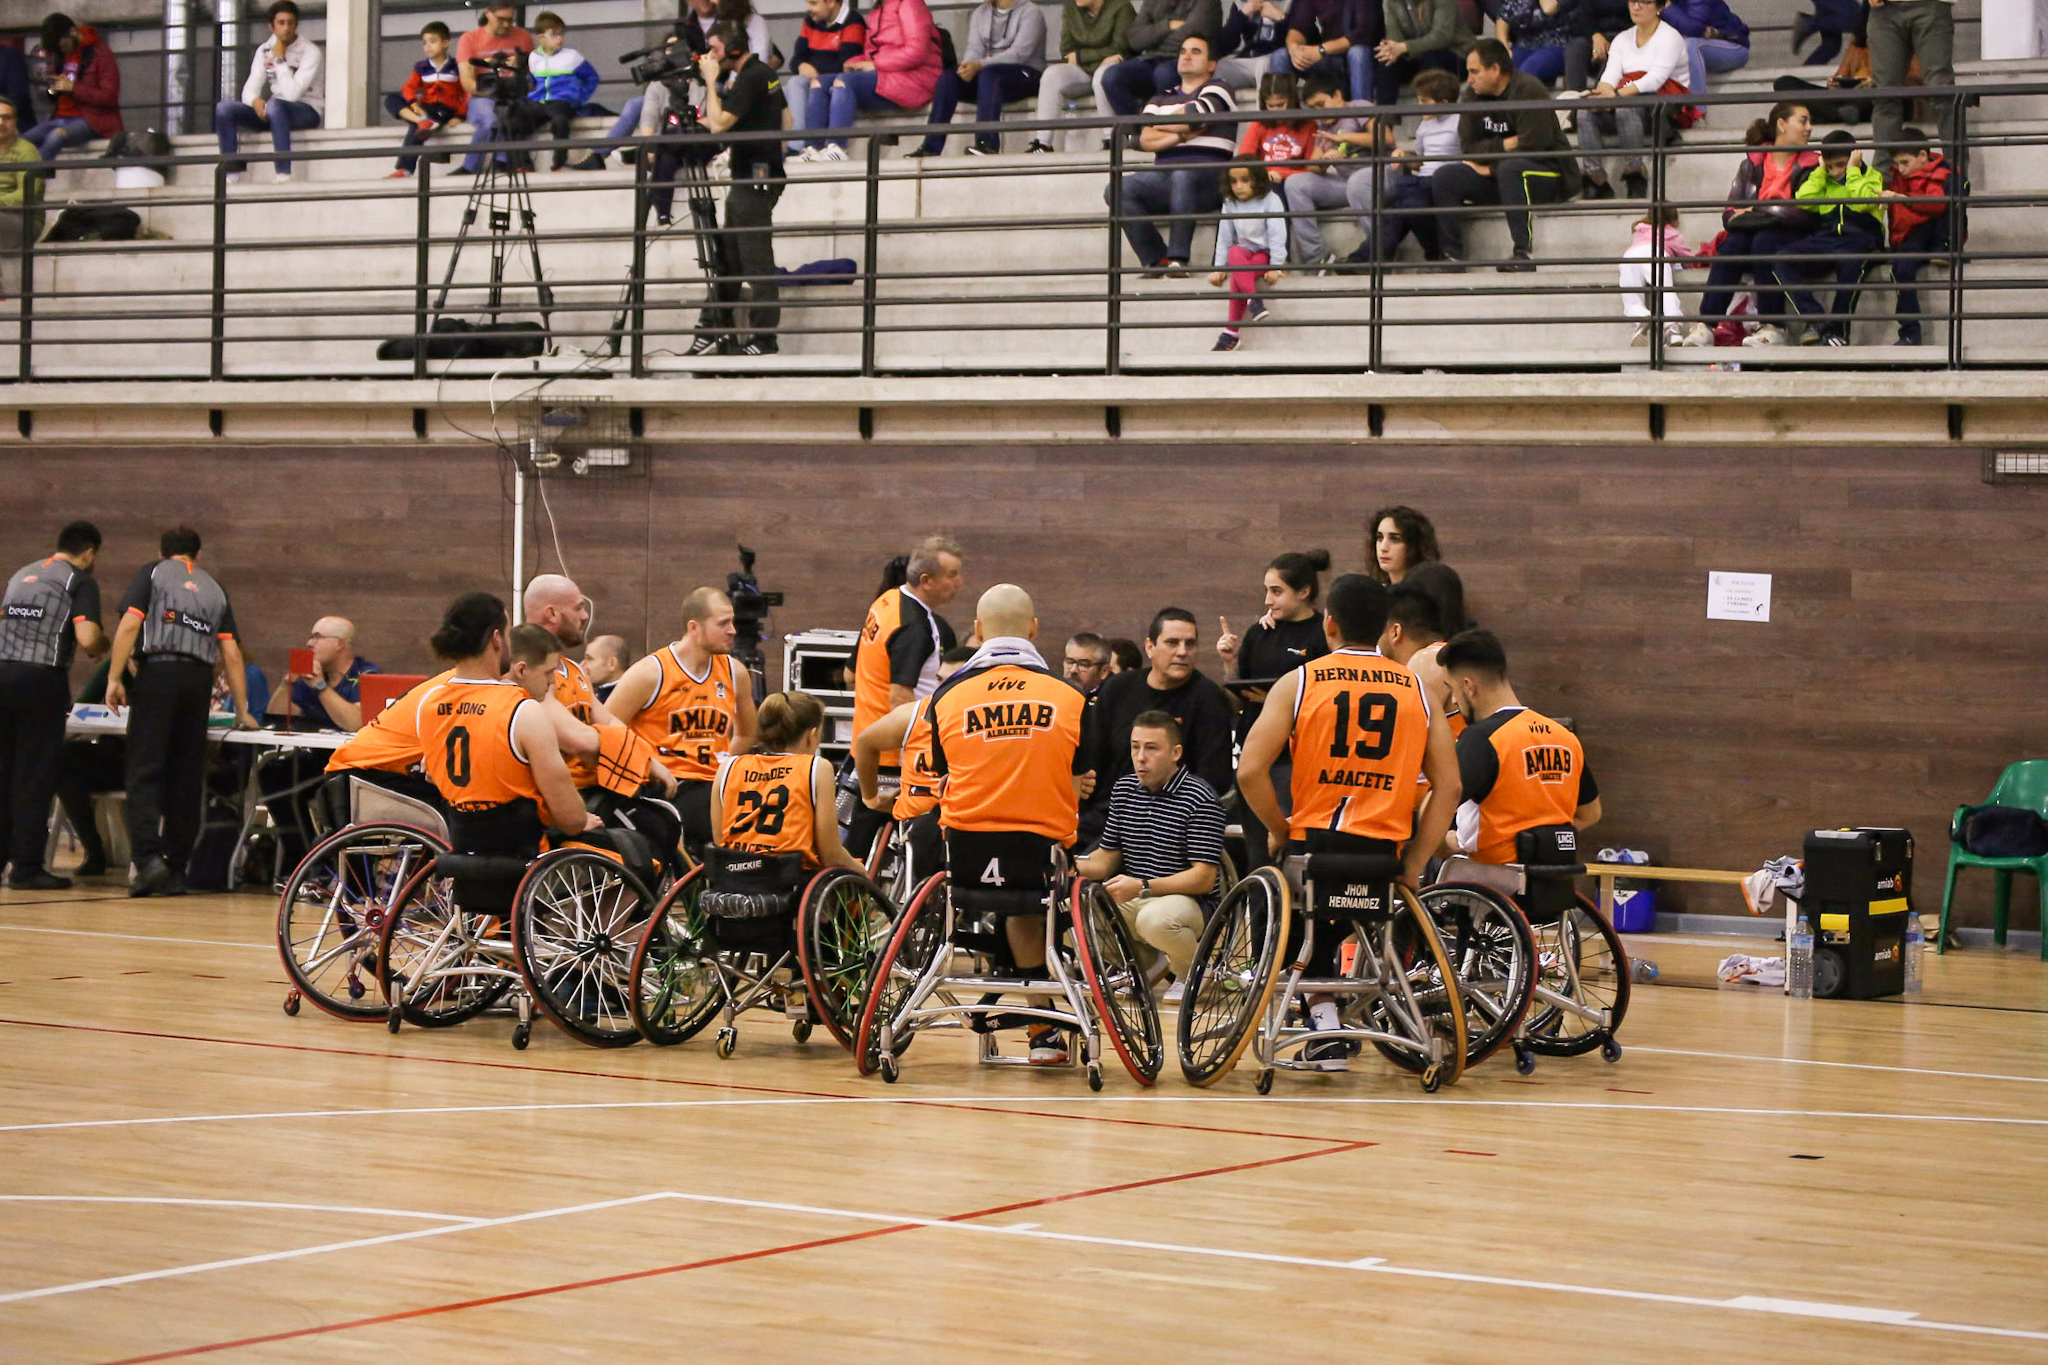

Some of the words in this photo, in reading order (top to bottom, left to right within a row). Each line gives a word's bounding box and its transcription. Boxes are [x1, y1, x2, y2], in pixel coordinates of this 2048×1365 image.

[1314, 667, 1412, 688] HERNANDEZ
[437, 703, 453, 716] DE
[456, 702, 487, 715] JONG
[966, 703, 1053, 733] AMIAB
[1330, 690, 1398, 760] 19
[986, 727, 1029, 739] ALBACETE
[446, 726, 471, 787] 0
[980, 857, 1005, 886] 4
[1344, 884, 1369, 896] JHON
[1877, 876, 1894, 889] amiab
[1328, 895, 1380, 910] HERNANDEZ
[1874, 947, 1892, 961] amiab
